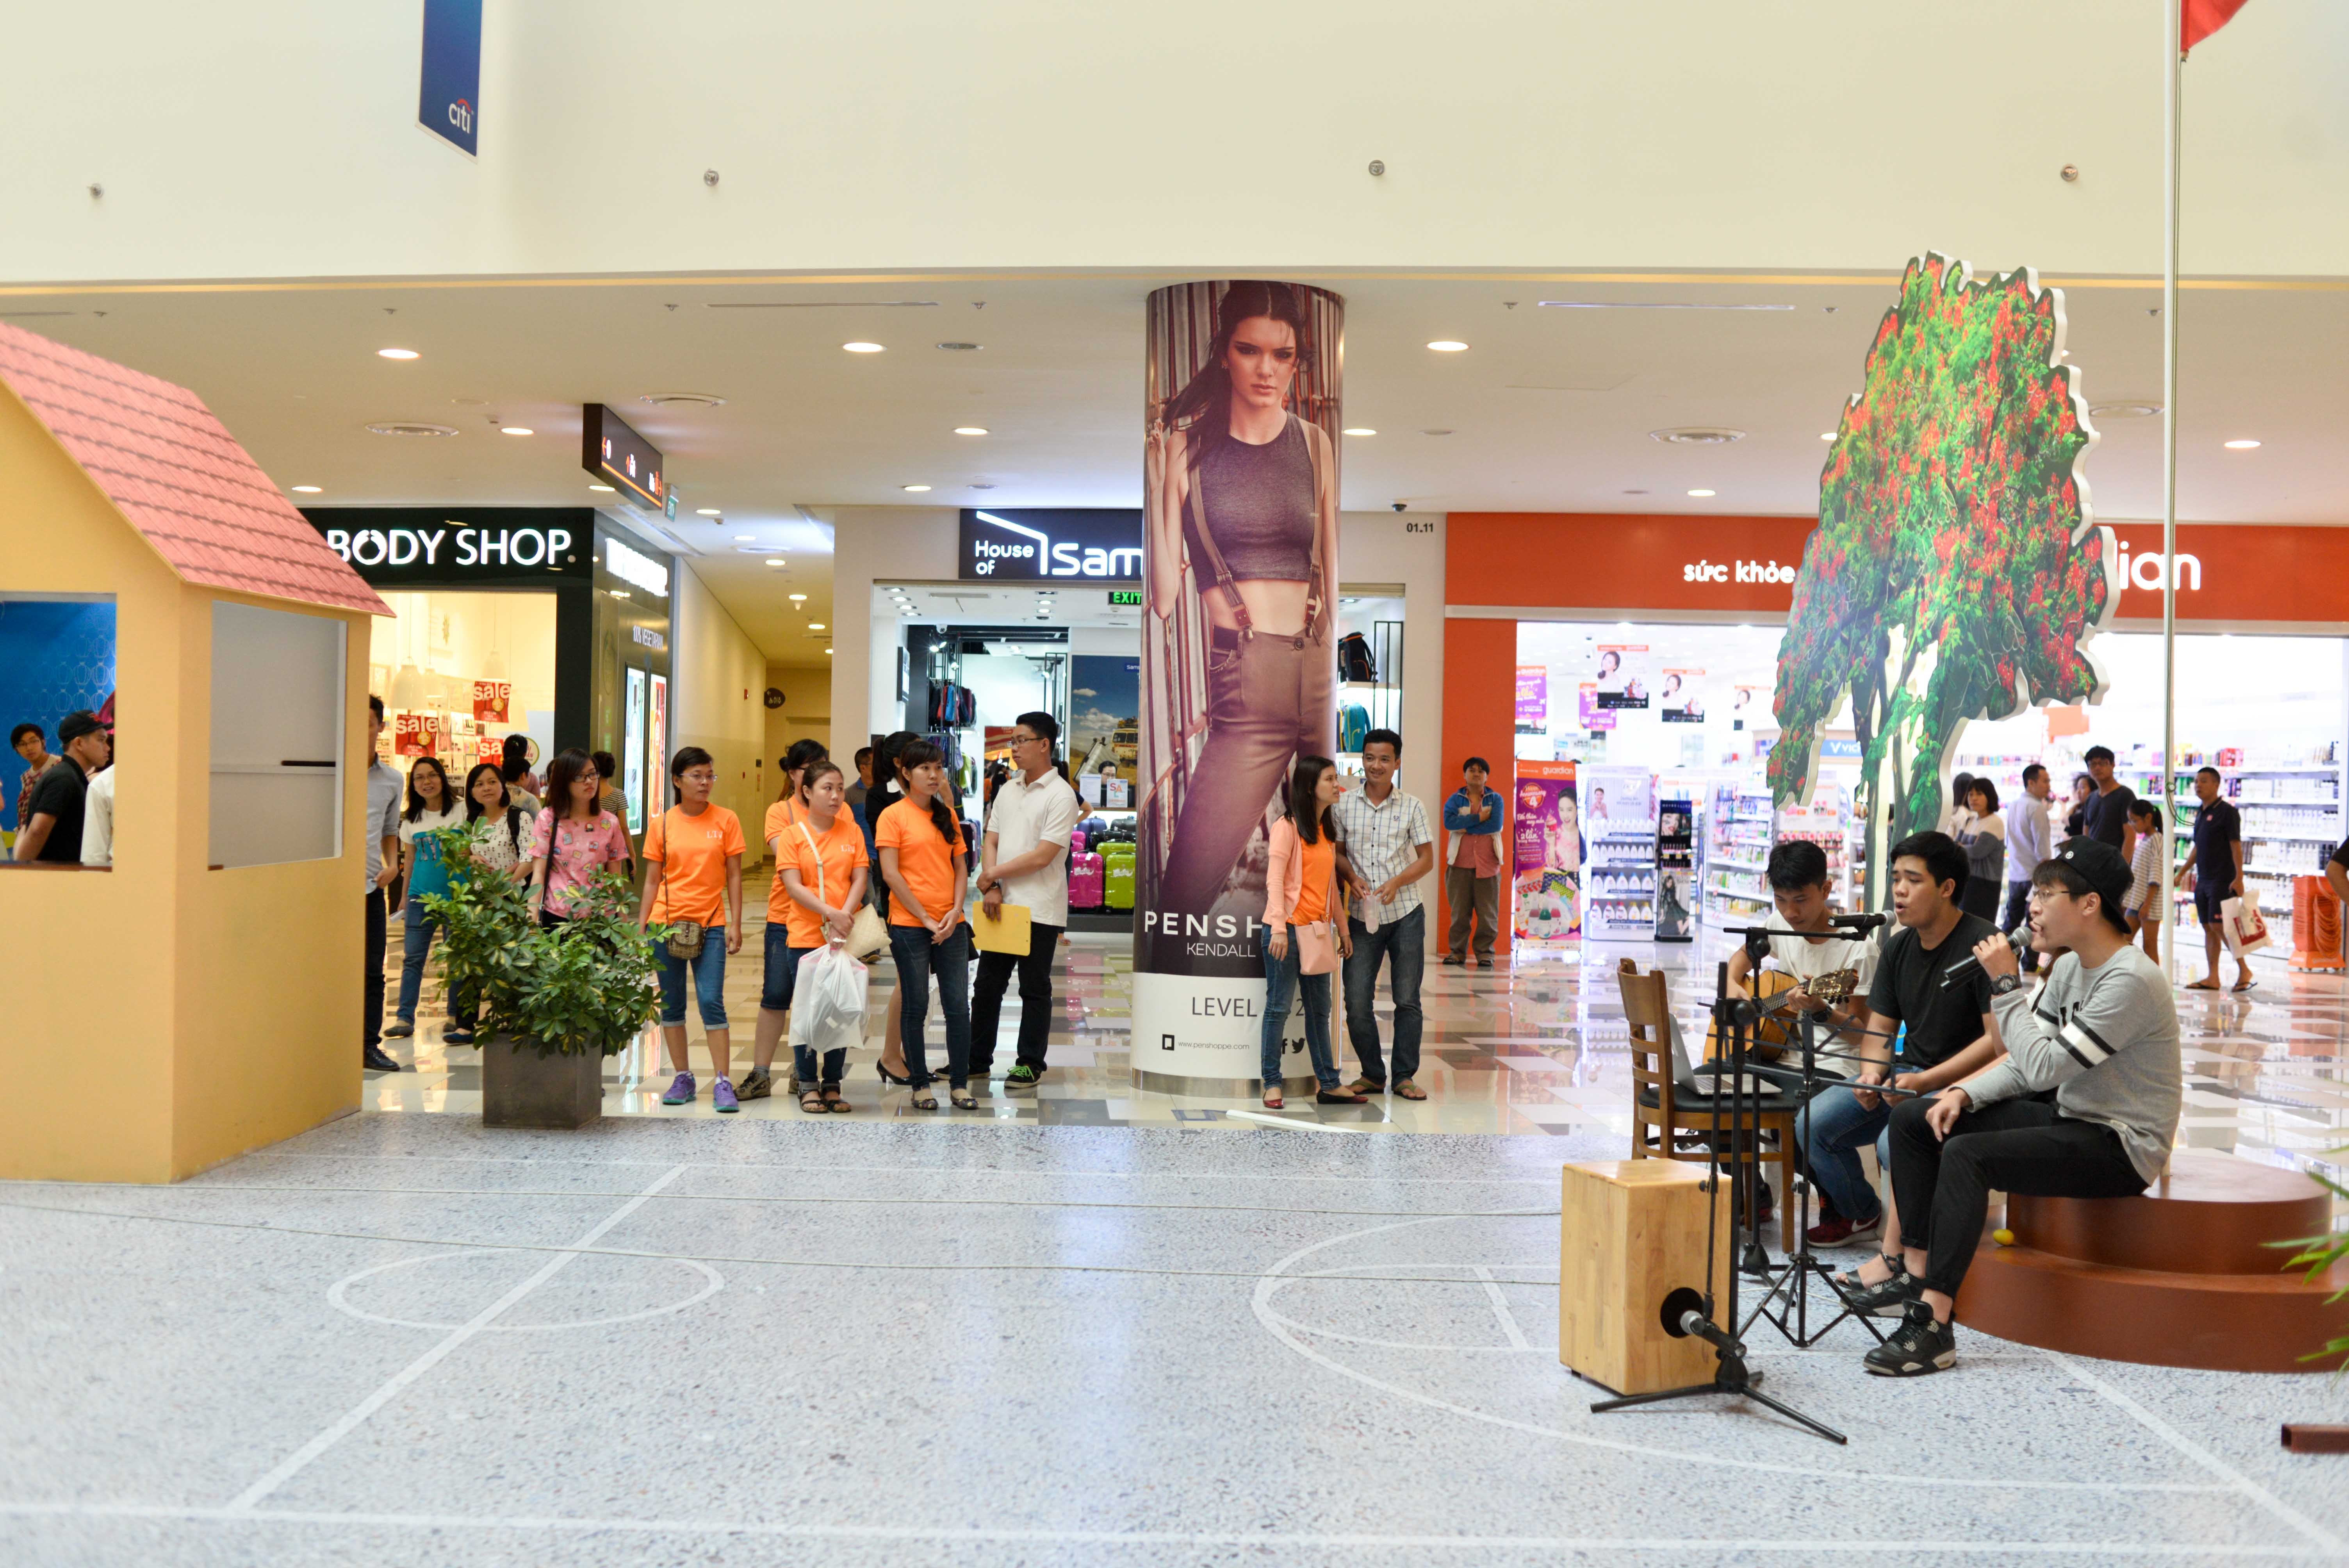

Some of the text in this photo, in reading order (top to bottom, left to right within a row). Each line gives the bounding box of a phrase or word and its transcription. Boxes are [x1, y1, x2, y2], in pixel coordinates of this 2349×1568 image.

[449, 102, 471, 134] citi
[1406, 523, 1434, 533] 01.11
[327, 529, 445, 565] BODY
[975, 540, 1034, 558] House
[975, 559, 995, 575] of
[1683, 559, 1796, 583] sức khỏe
[2115, 540, 2201, 590] ian
[1113, 592, 1142, 604] EXIT
[642, 627, 663, 650] VEGETARIAN
[473, 682, 511, 701] sale
[396, 714, 438, 734] sale
[479, 742, 503, 757] sa
[1543, 766, 1574, 775] guardian
[1187, 943, 1256, 957] KENDALL
[1192, 996, 1257, 1017] LEVEL
[1178, 1041, 1250, 1050] www.penshoppe.com
